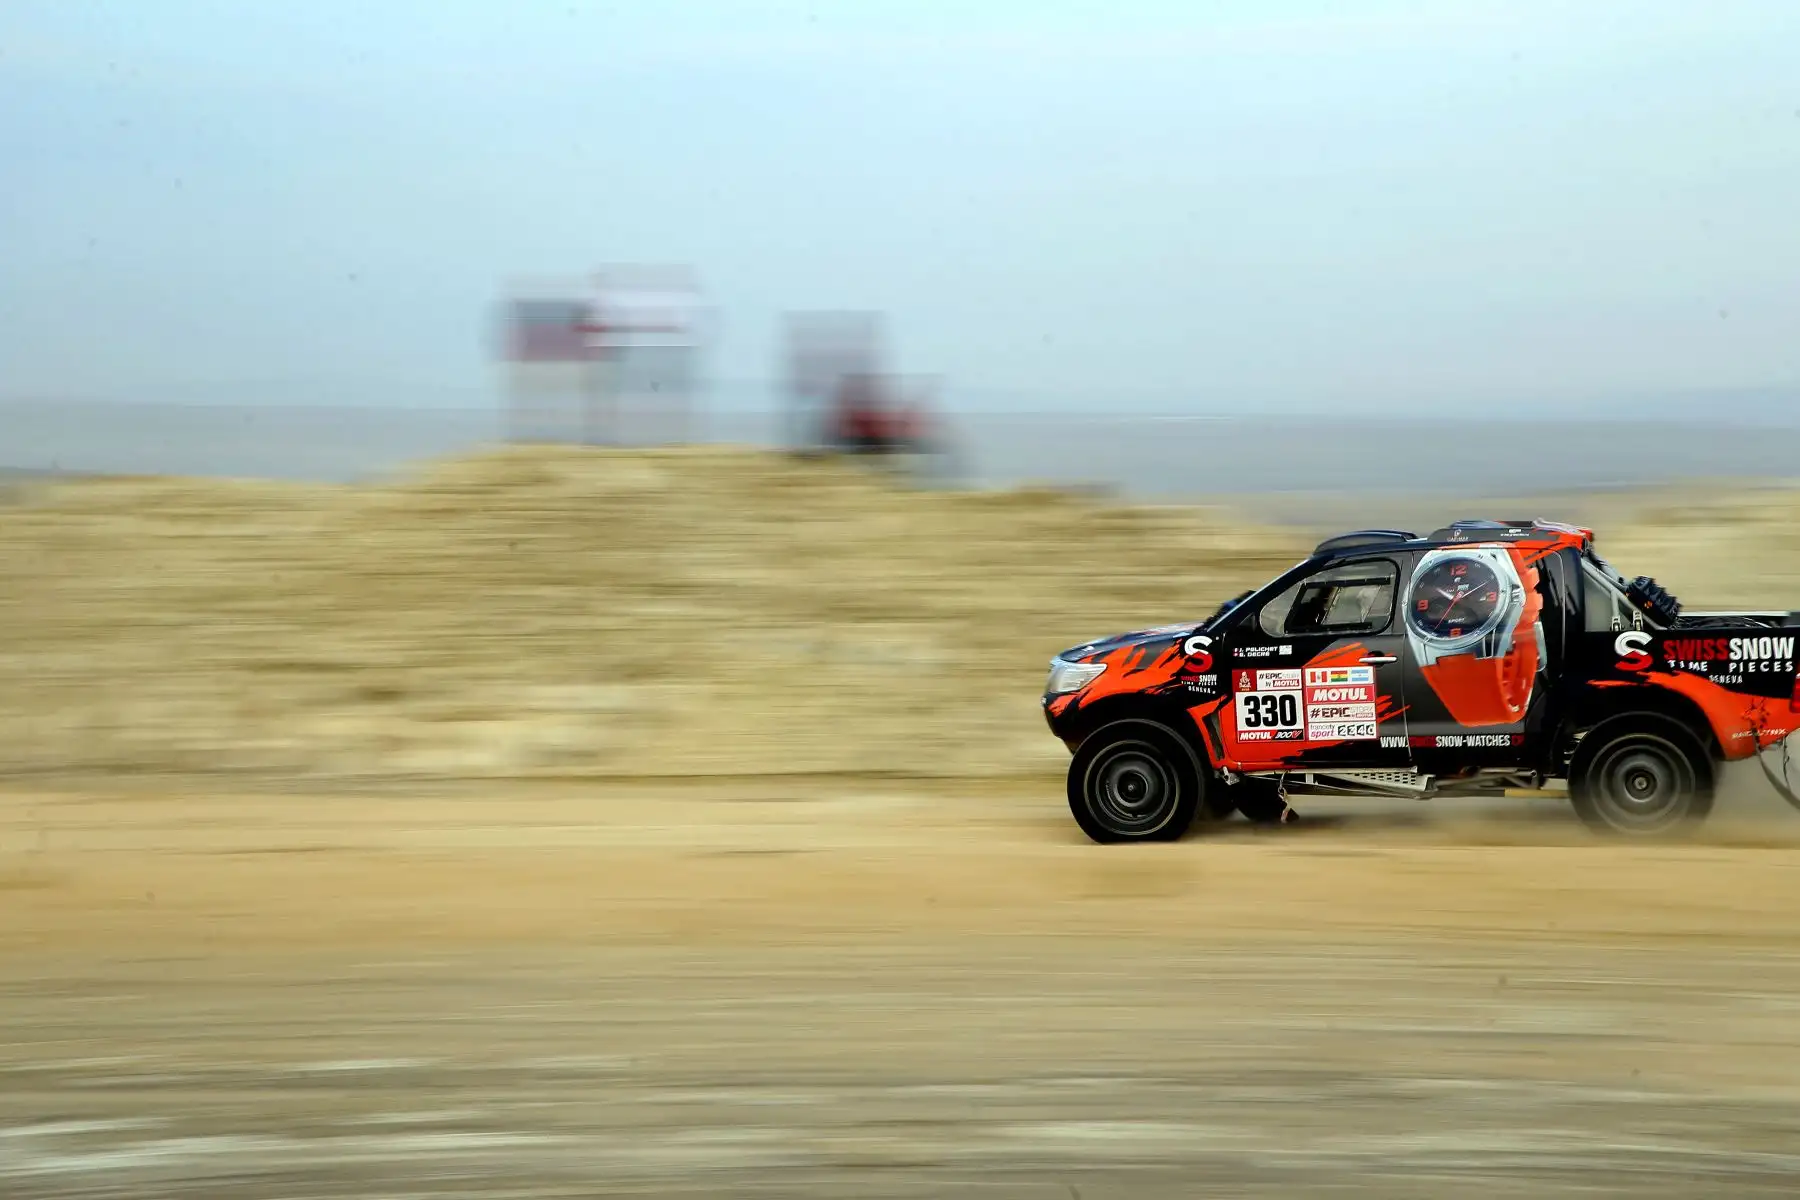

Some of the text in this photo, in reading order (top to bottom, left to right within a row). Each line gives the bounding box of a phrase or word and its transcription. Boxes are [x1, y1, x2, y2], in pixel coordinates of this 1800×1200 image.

[1668, 660, 1794, 672] TIME PIECES
[1709, 675, 1743, 683] GENEVA
[1313, 687, 1368, 702] MOTUL
[1244, 694, 1298, 727] 330
[1240, 731, 1272, 740] MOTUL
[1311, 729, 1335, 738] sport
